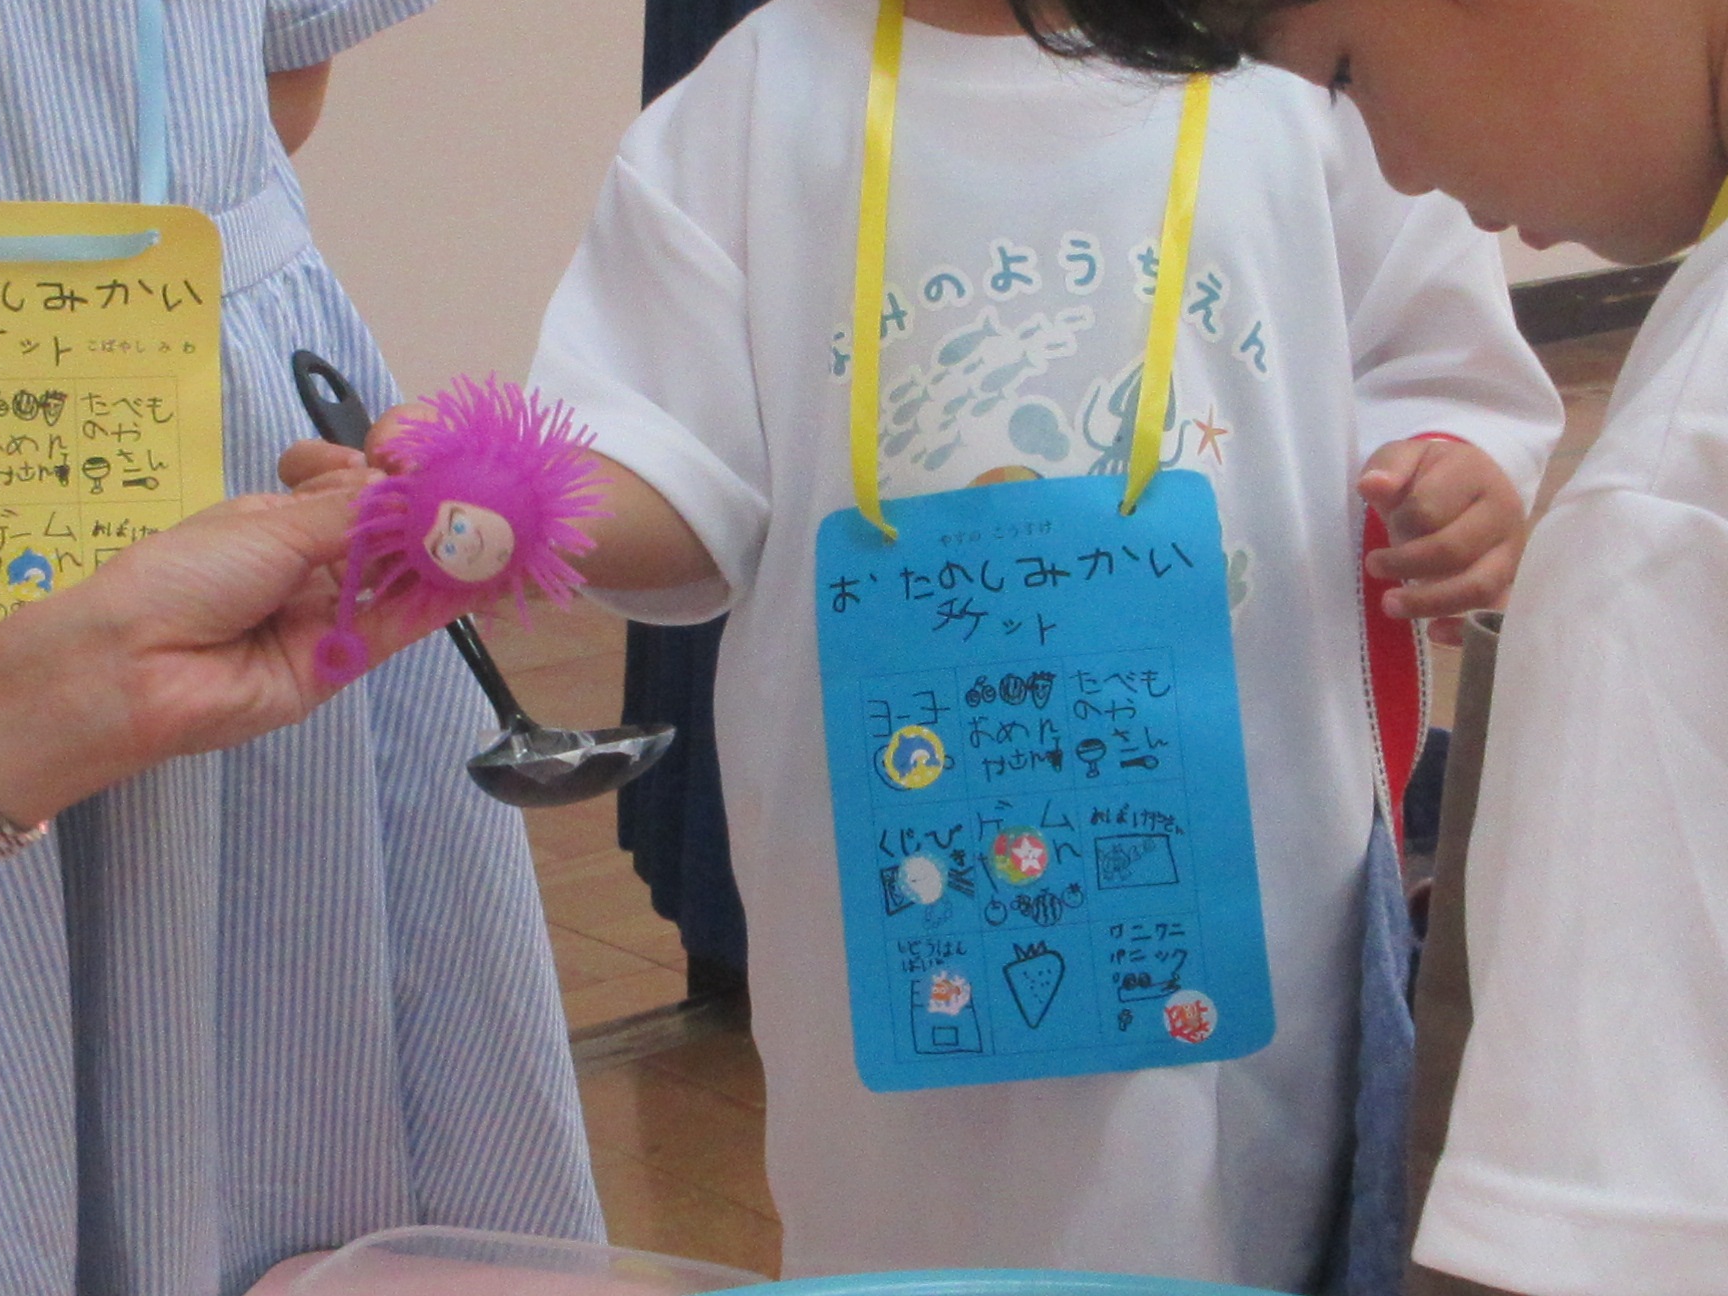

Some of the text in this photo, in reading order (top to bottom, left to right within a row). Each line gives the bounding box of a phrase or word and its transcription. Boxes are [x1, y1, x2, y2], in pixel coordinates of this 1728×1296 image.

[829, 542, 1194, 613] おたのしみかい
